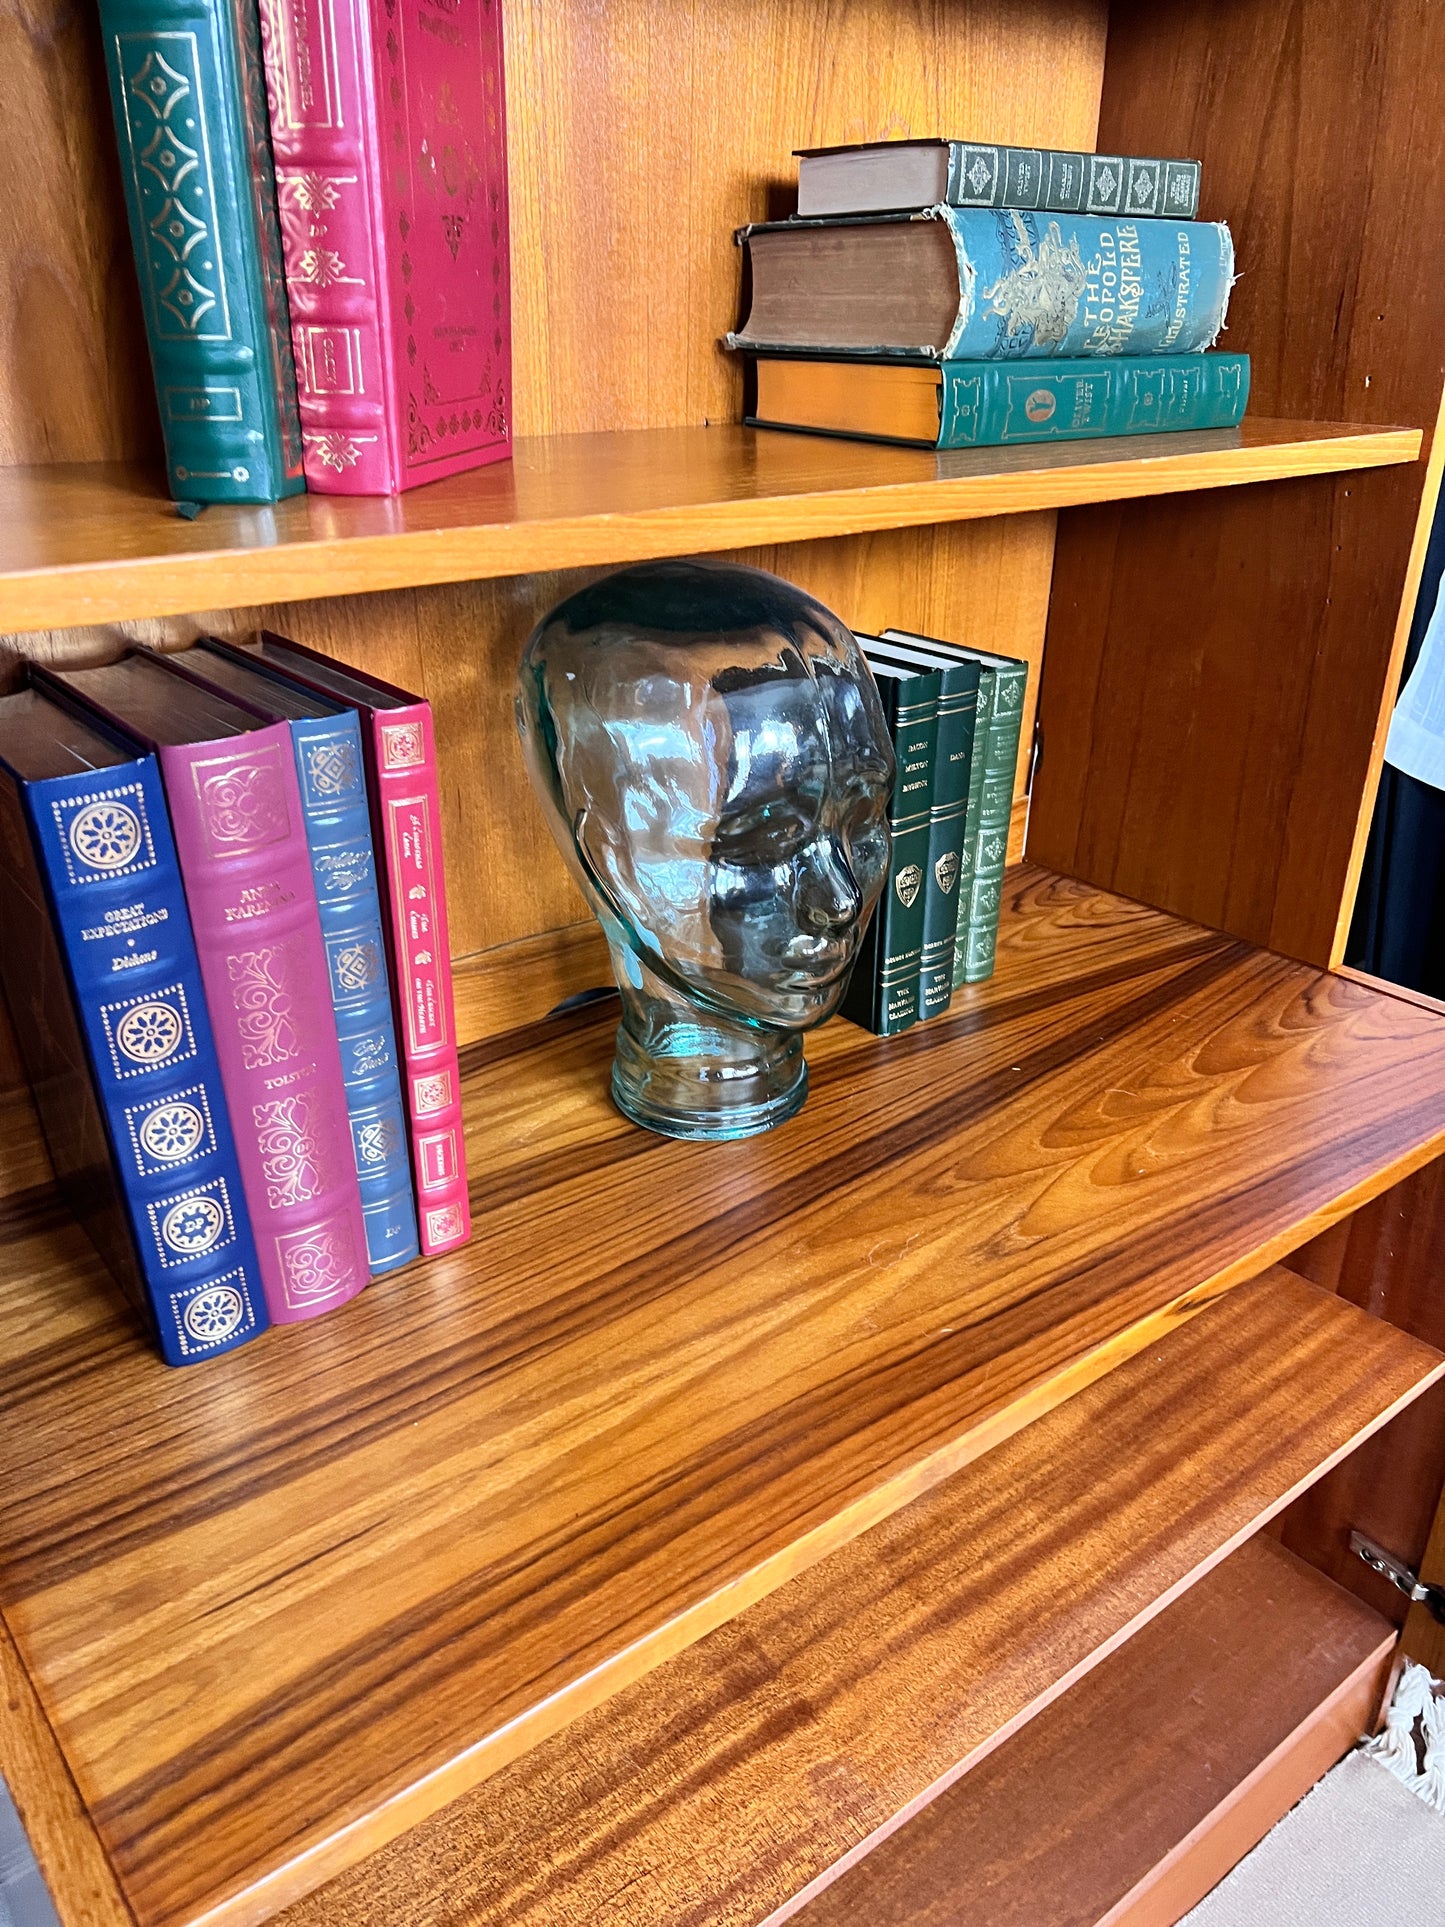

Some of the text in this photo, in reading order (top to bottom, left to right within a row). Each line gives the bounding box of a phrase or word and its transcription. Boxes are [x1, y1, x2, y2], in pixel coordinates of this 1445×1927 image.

[1083, 252, 1102, 328] THE
[1083, 232, 1117, 350] LEOPOLD
[1094, 224, 1145, 357] SHAKSPERE
[1152, 231, 1191, 353] ILLUSTRATED
[1072, 379, 1084, 429] OLIVER
[1081, 382, 1093, 425] TWIST
[80, 907, 169, 941] EXPECTATIONS
[104, 902, 145, 923] GREAT
